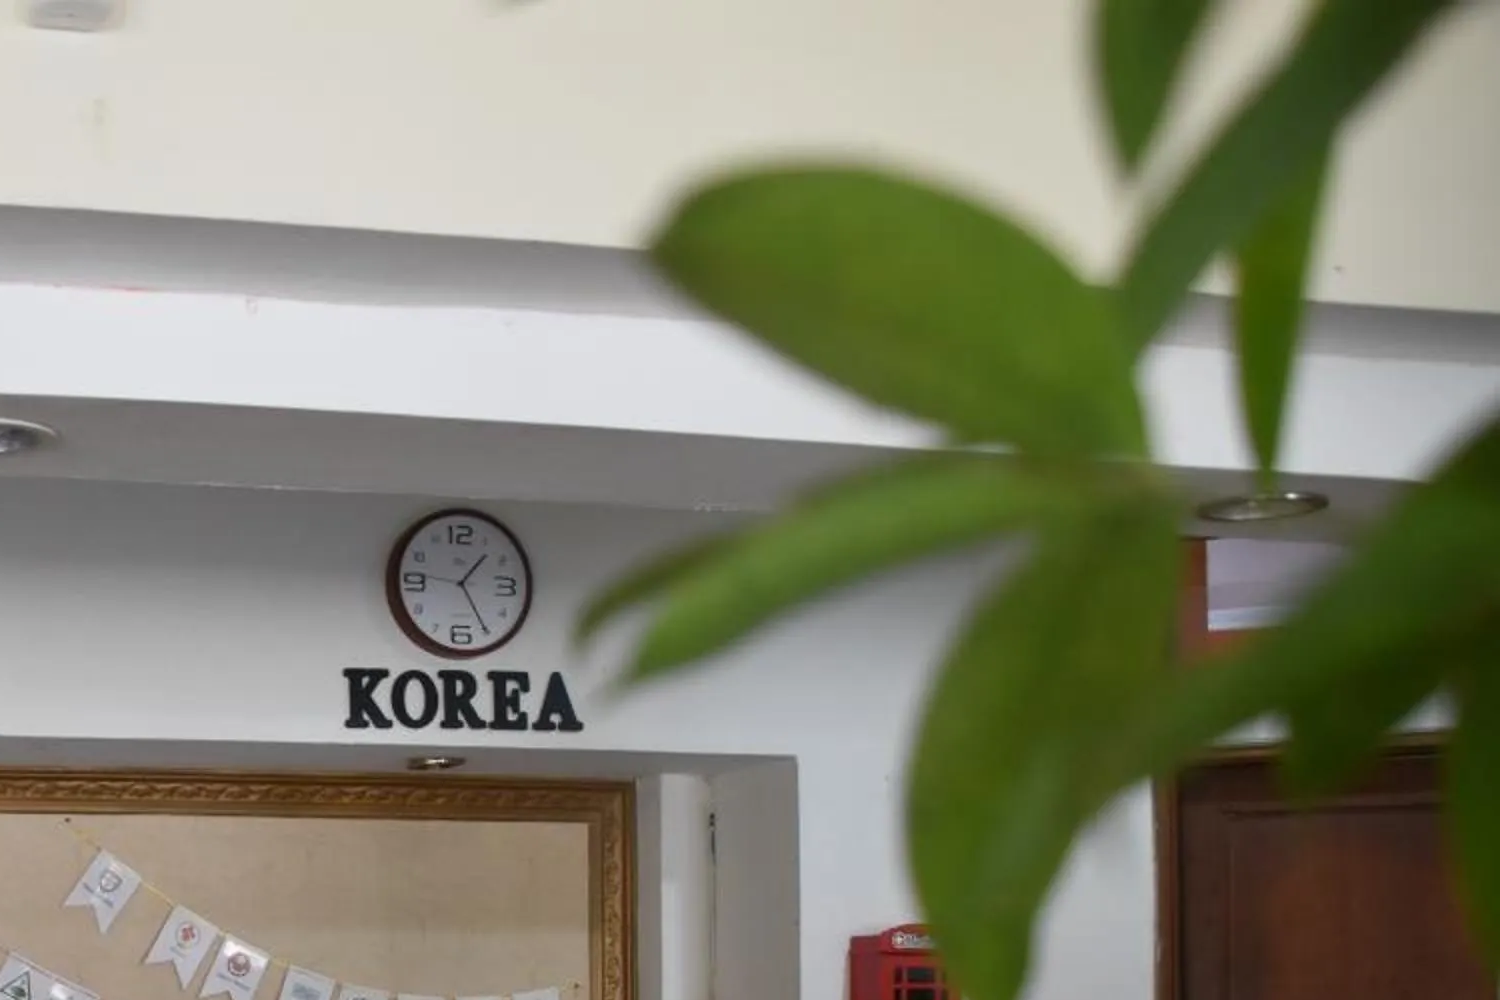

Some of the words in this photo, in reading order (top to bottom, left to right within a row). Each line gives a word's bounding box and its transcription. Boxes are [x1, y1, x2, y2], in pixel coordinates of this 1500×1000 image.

[448, 525, 473, 545] 12
[404, 572, 426, 593] 9
[493, 575, 517, 597] 3
[451, 625, 473, 645] 6
[342, 668, 584, 731] KOREA
